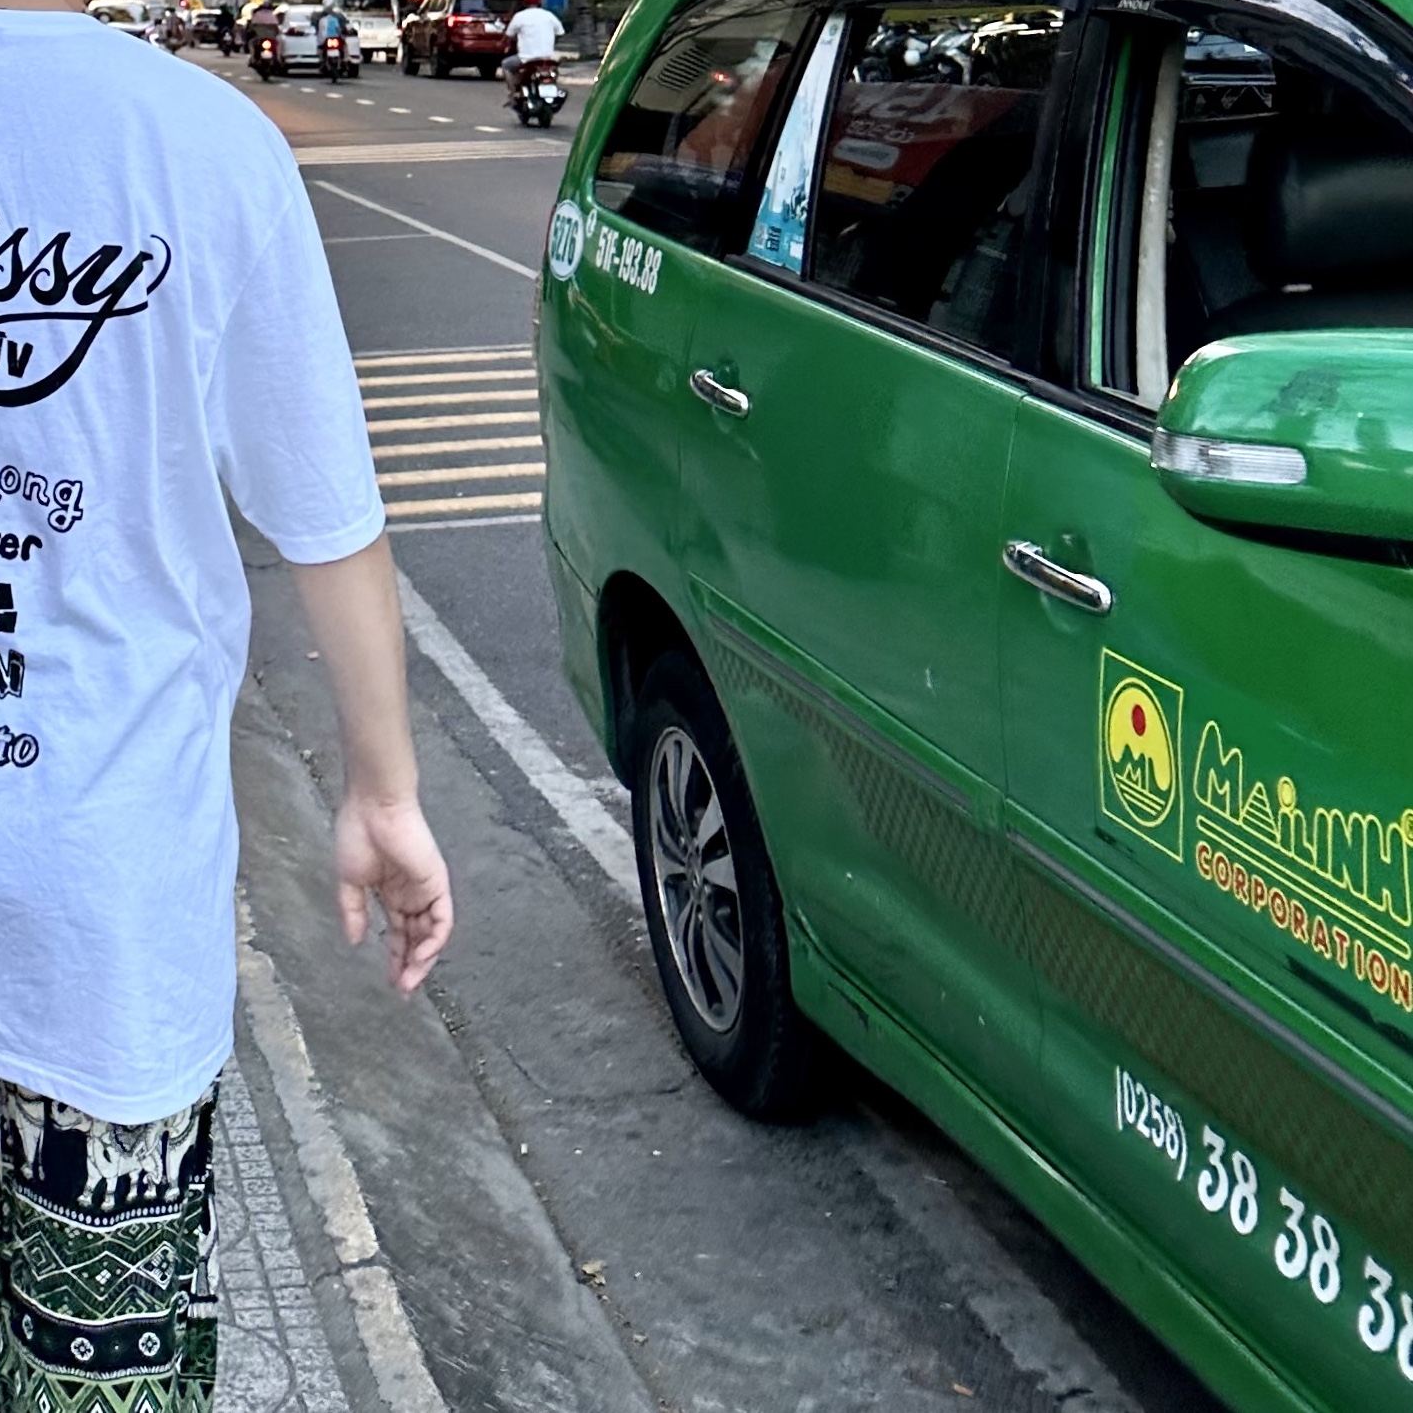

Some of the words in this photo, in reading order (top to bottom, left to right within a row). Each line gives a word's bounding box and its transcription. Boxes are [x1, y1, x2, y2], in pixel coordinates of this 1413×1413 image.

[596, 225, 663, 295] 51F-193.88
[1196, 840, 1413, 1013] CORPORATION
[1116, 1064, 1188, 1182] (0258)
[1197, 1124, 1258, 1236] 38
[1274, 1186, 1341, 1305] 38
